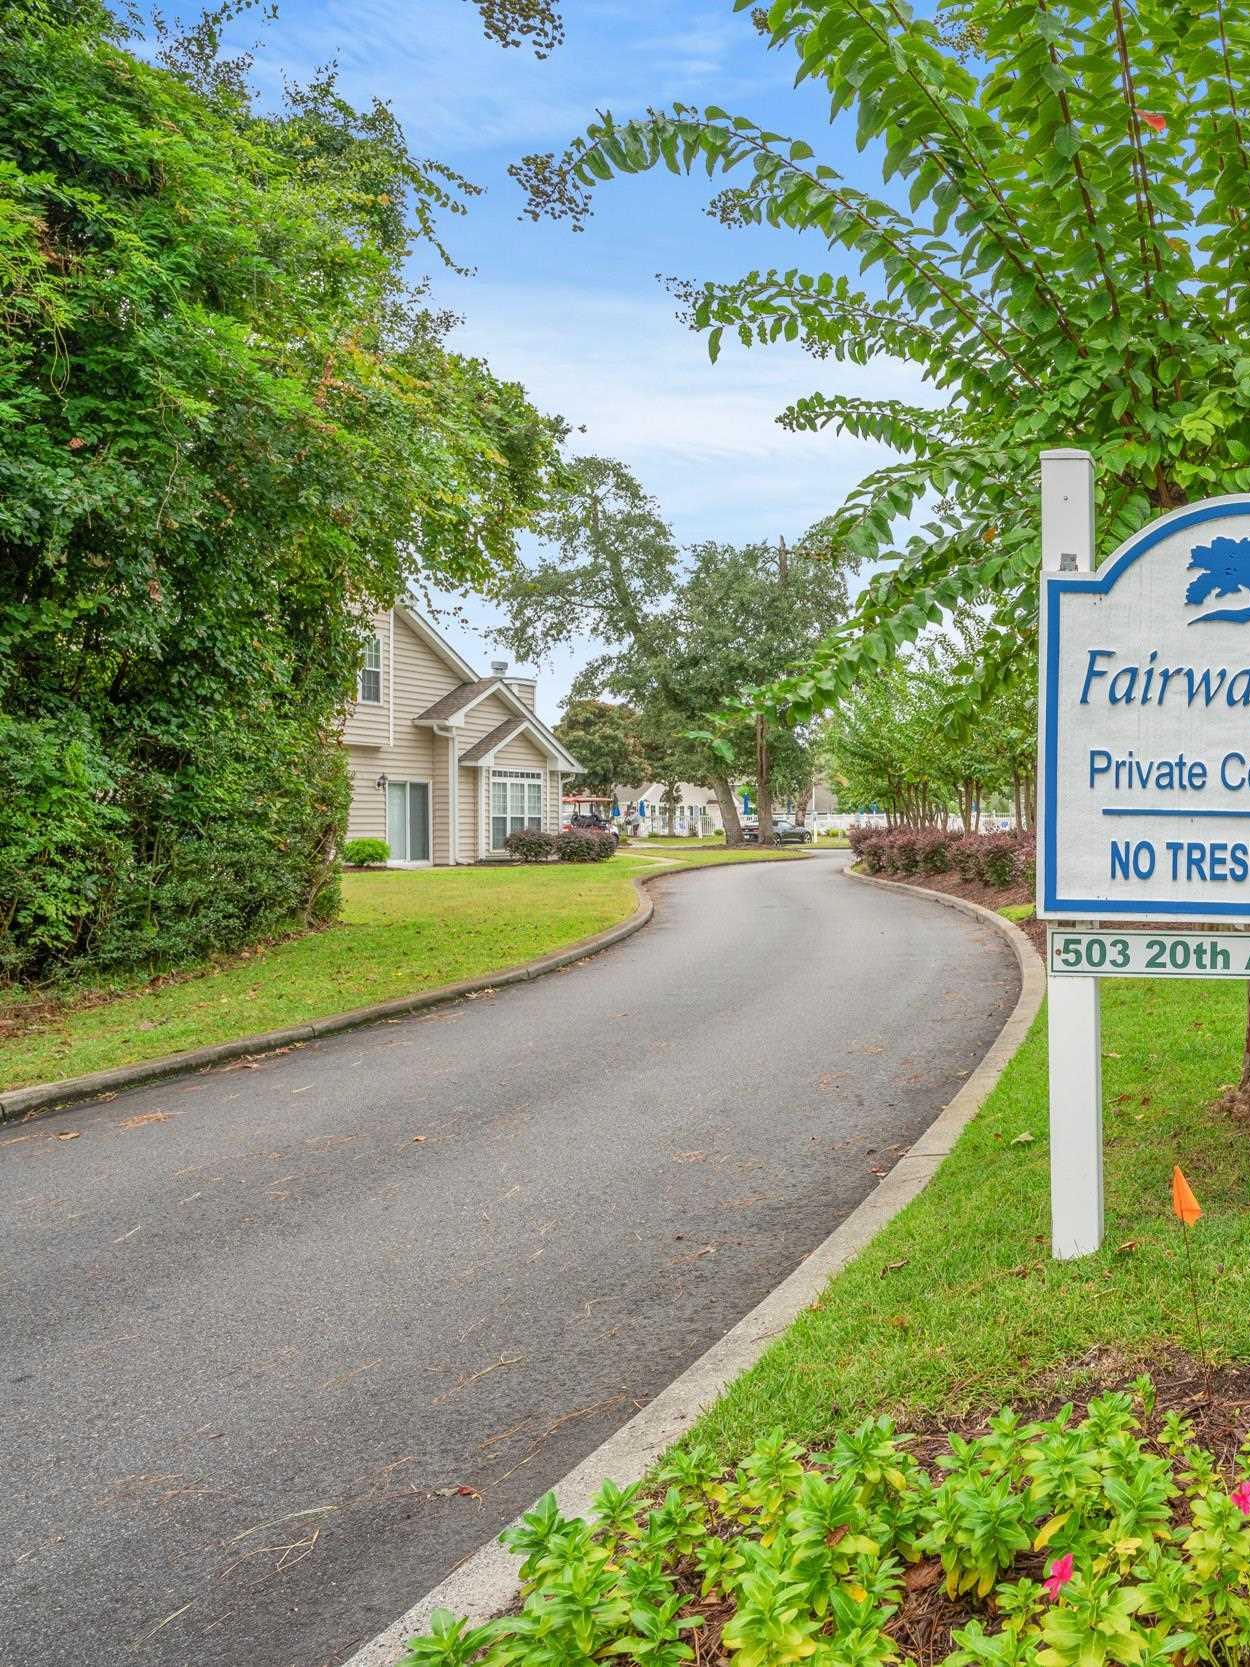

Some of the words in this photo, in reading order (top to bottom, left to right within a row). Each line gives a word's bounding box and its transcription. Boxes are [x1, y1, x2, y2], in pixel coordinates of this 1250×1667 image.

[1088, 749, 1207, 792] Private
[1110, 839, 1155, 881] NO
[1061, 938, 1130, 969] 503
[1145, 939, 1231, 970] 20th
